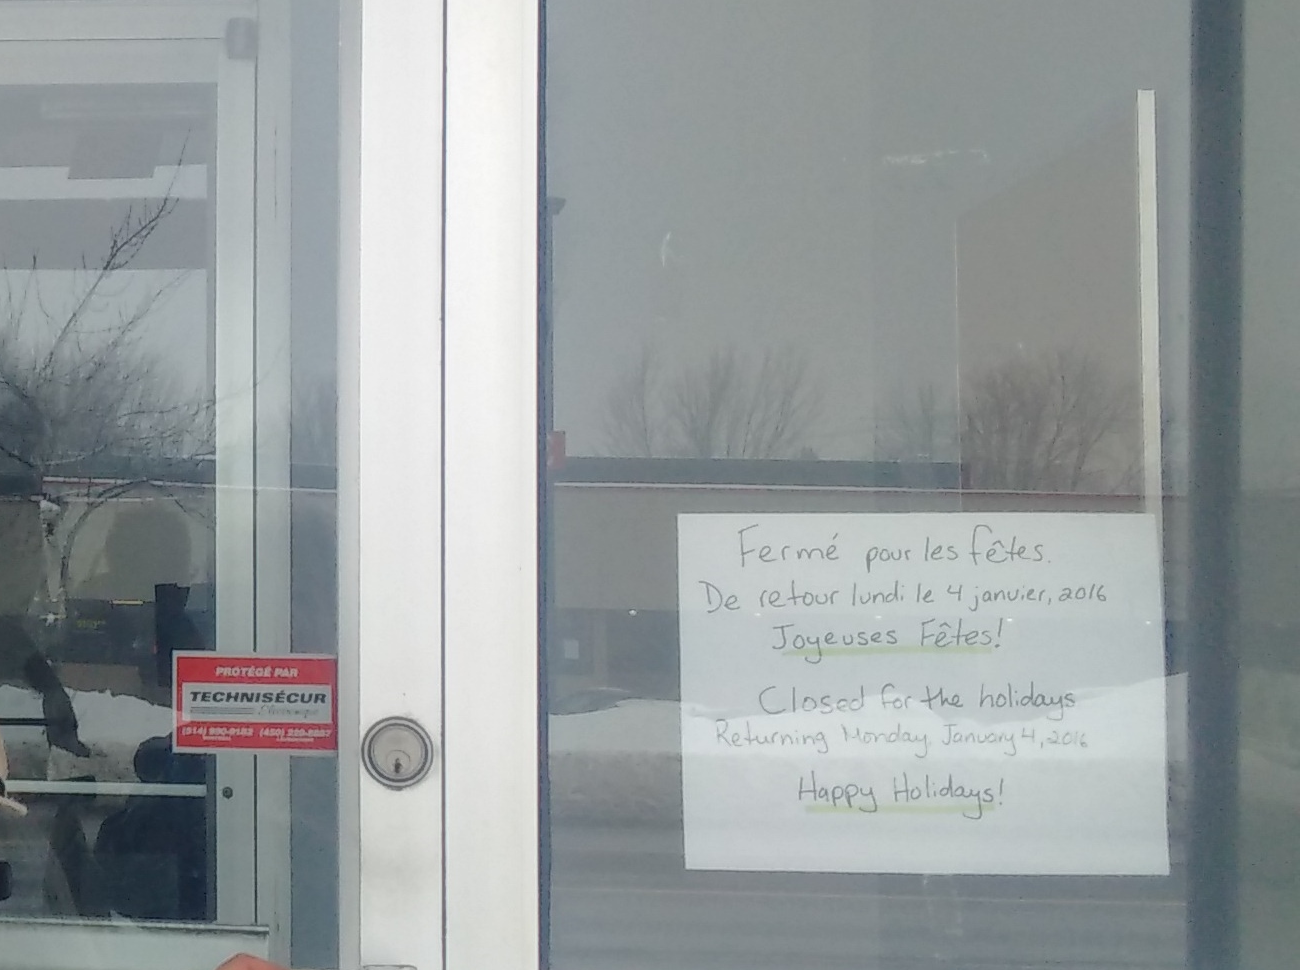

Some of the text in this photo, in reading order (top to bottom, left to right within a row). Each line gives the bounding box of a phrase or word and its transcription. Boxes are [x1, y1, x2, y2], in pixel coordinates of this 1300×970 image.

[737, 523, 840, 568] Fermé
[865, 545, 912, 574] pour
[924, 536, 959, 562] les
[698, 579, 1108, 614] De retour lundi le 4 janvier, 2016
[771, 617, 1004, 665] Joyeuses Fêtes!
[215, 665, 299, 678] PROTÉGÉ PAR
[189, 689, 328, 704] TECHNISÉCUR
[758, 681, 1077, 722] Closed for the holidays
[715, 718, 830, 755] Returning
[941, 723, 1018, 757] January
[1046, 730, 1089, 748] 2016
[798, 770, 1004, 820] Happy Holidays!
